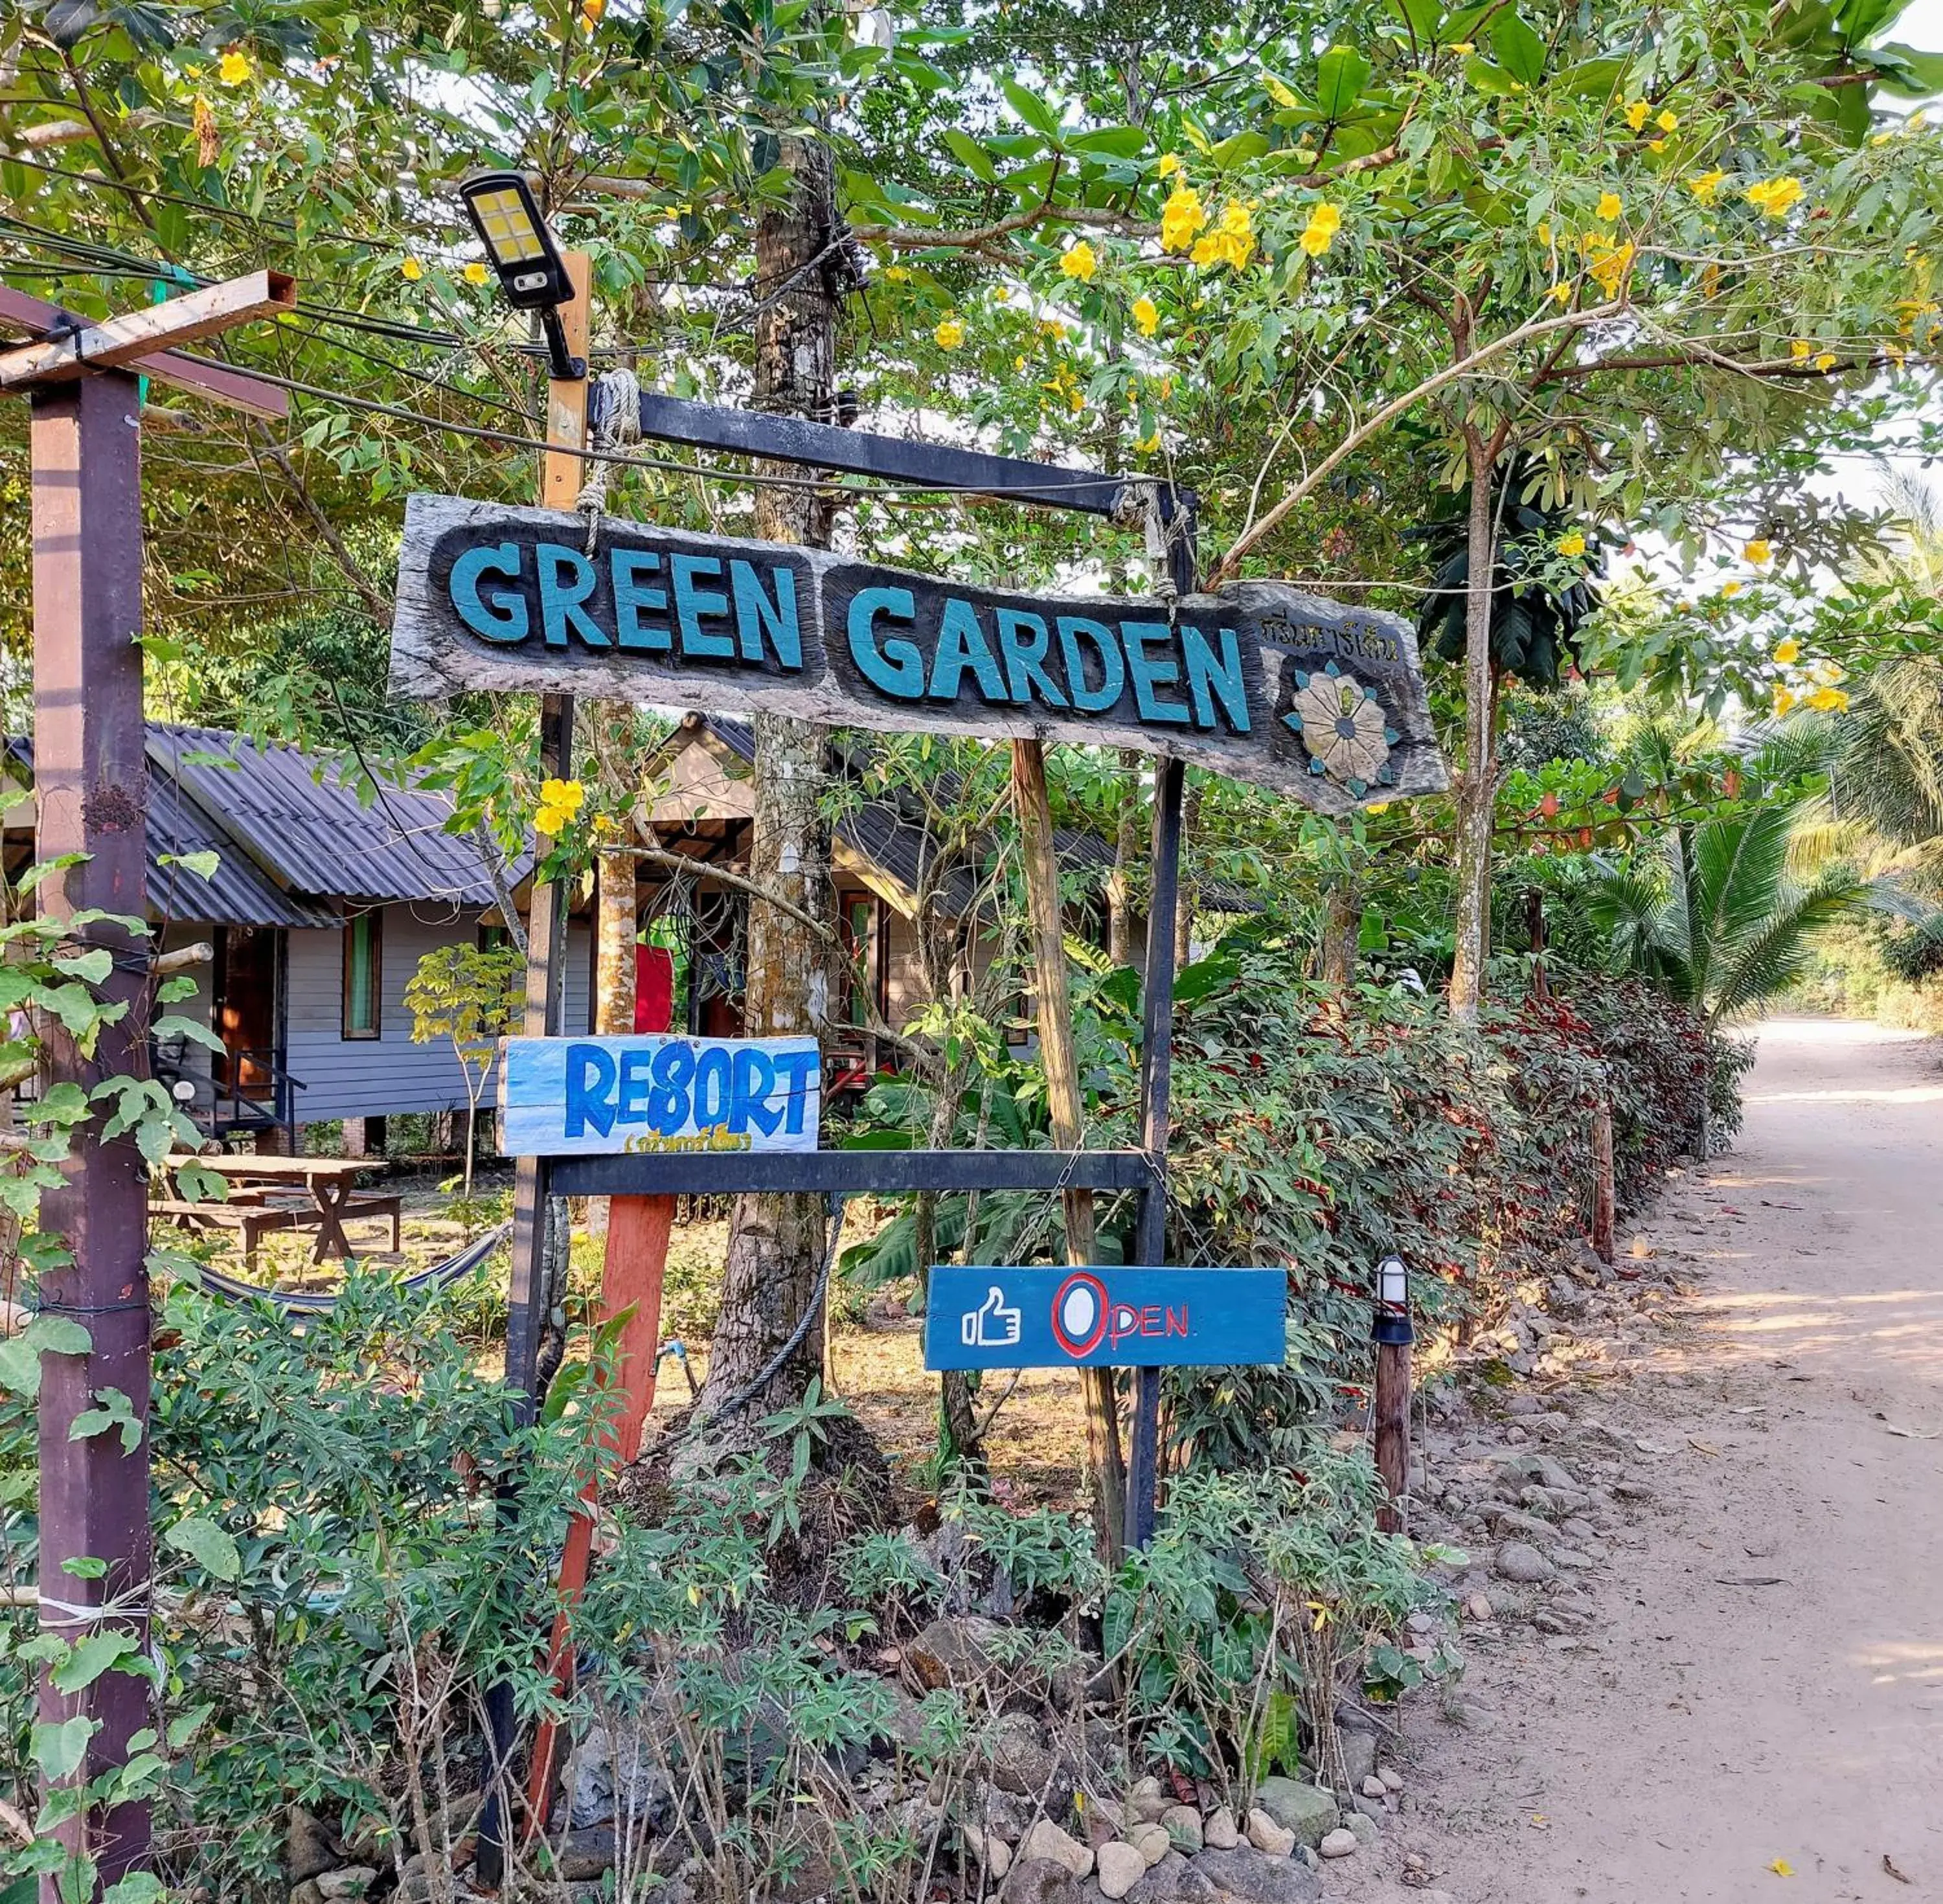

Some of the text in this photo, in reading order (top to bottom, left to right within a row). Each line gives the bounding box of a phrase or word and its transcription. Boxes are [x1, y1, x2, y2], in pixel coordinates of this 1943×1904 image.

[449, 543, 1251, 732] GREEN GARDEN
[564, 1043, 820, 1139] RESORT
